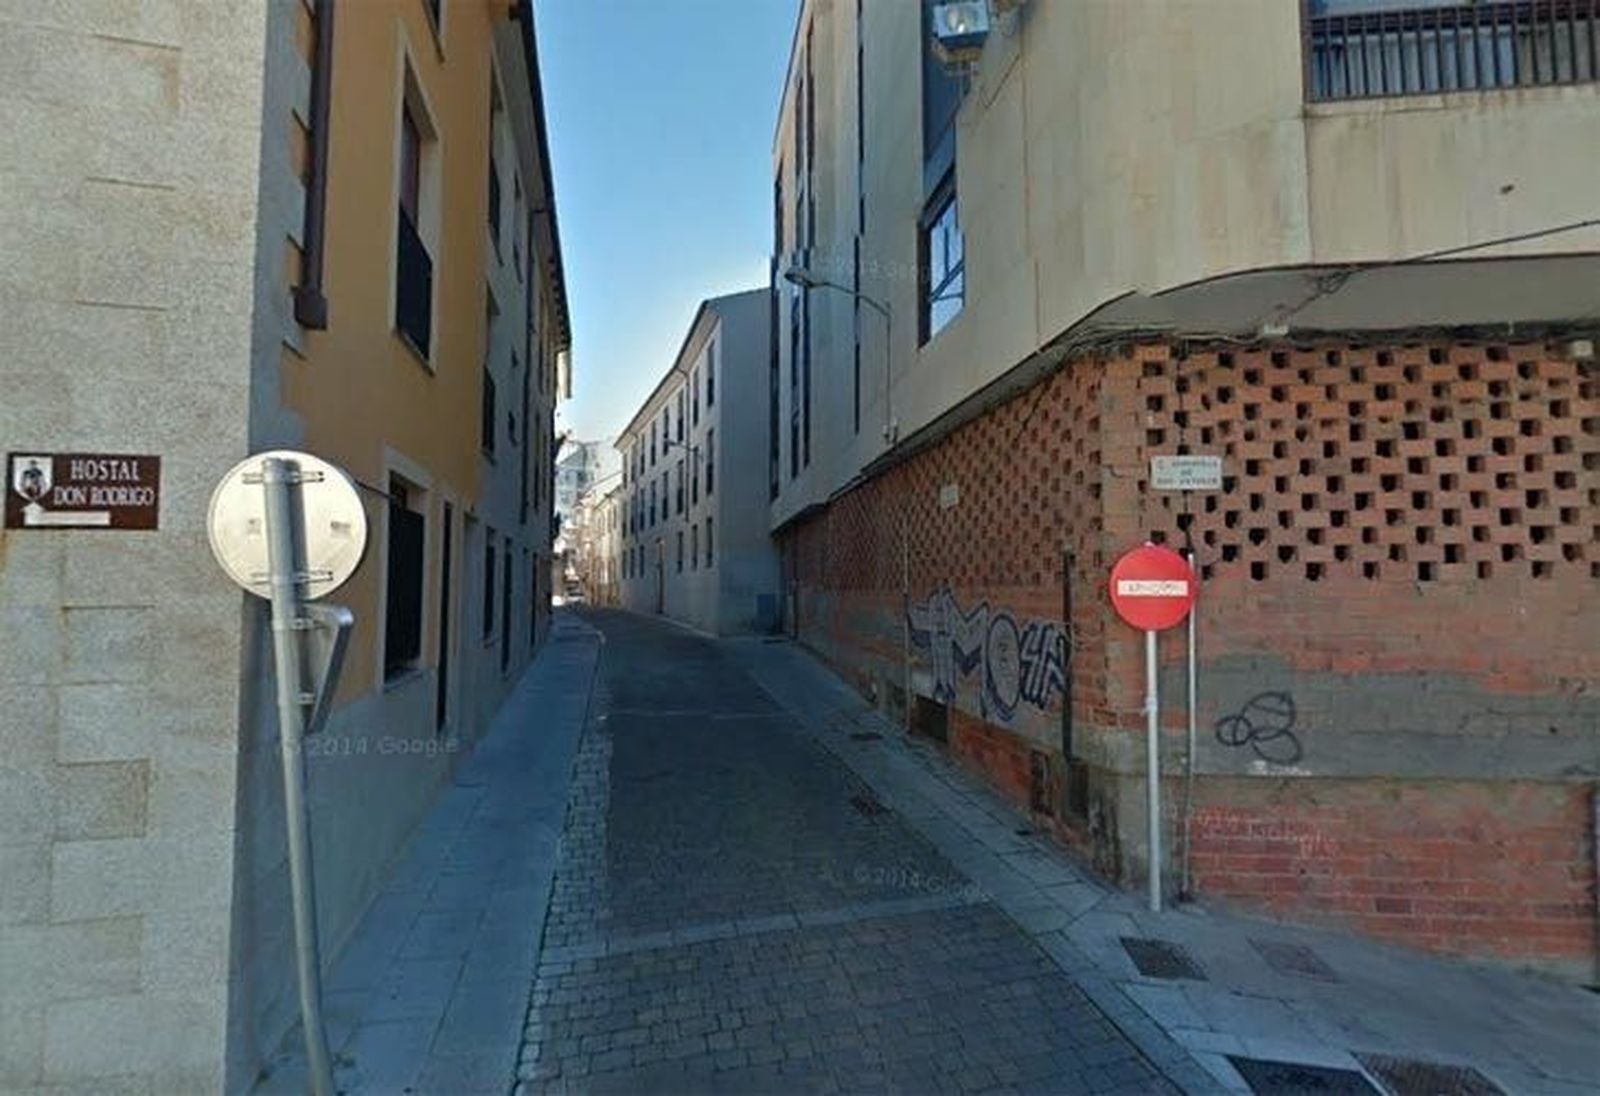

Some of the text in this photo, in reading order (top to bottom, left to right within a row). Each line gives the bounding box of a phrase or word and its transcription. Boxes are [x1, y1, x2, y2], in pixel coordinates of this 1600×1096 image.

[71, 459, 140, 480] HOSTAL
[53, 486, 154, 505] DON RODRIGO
